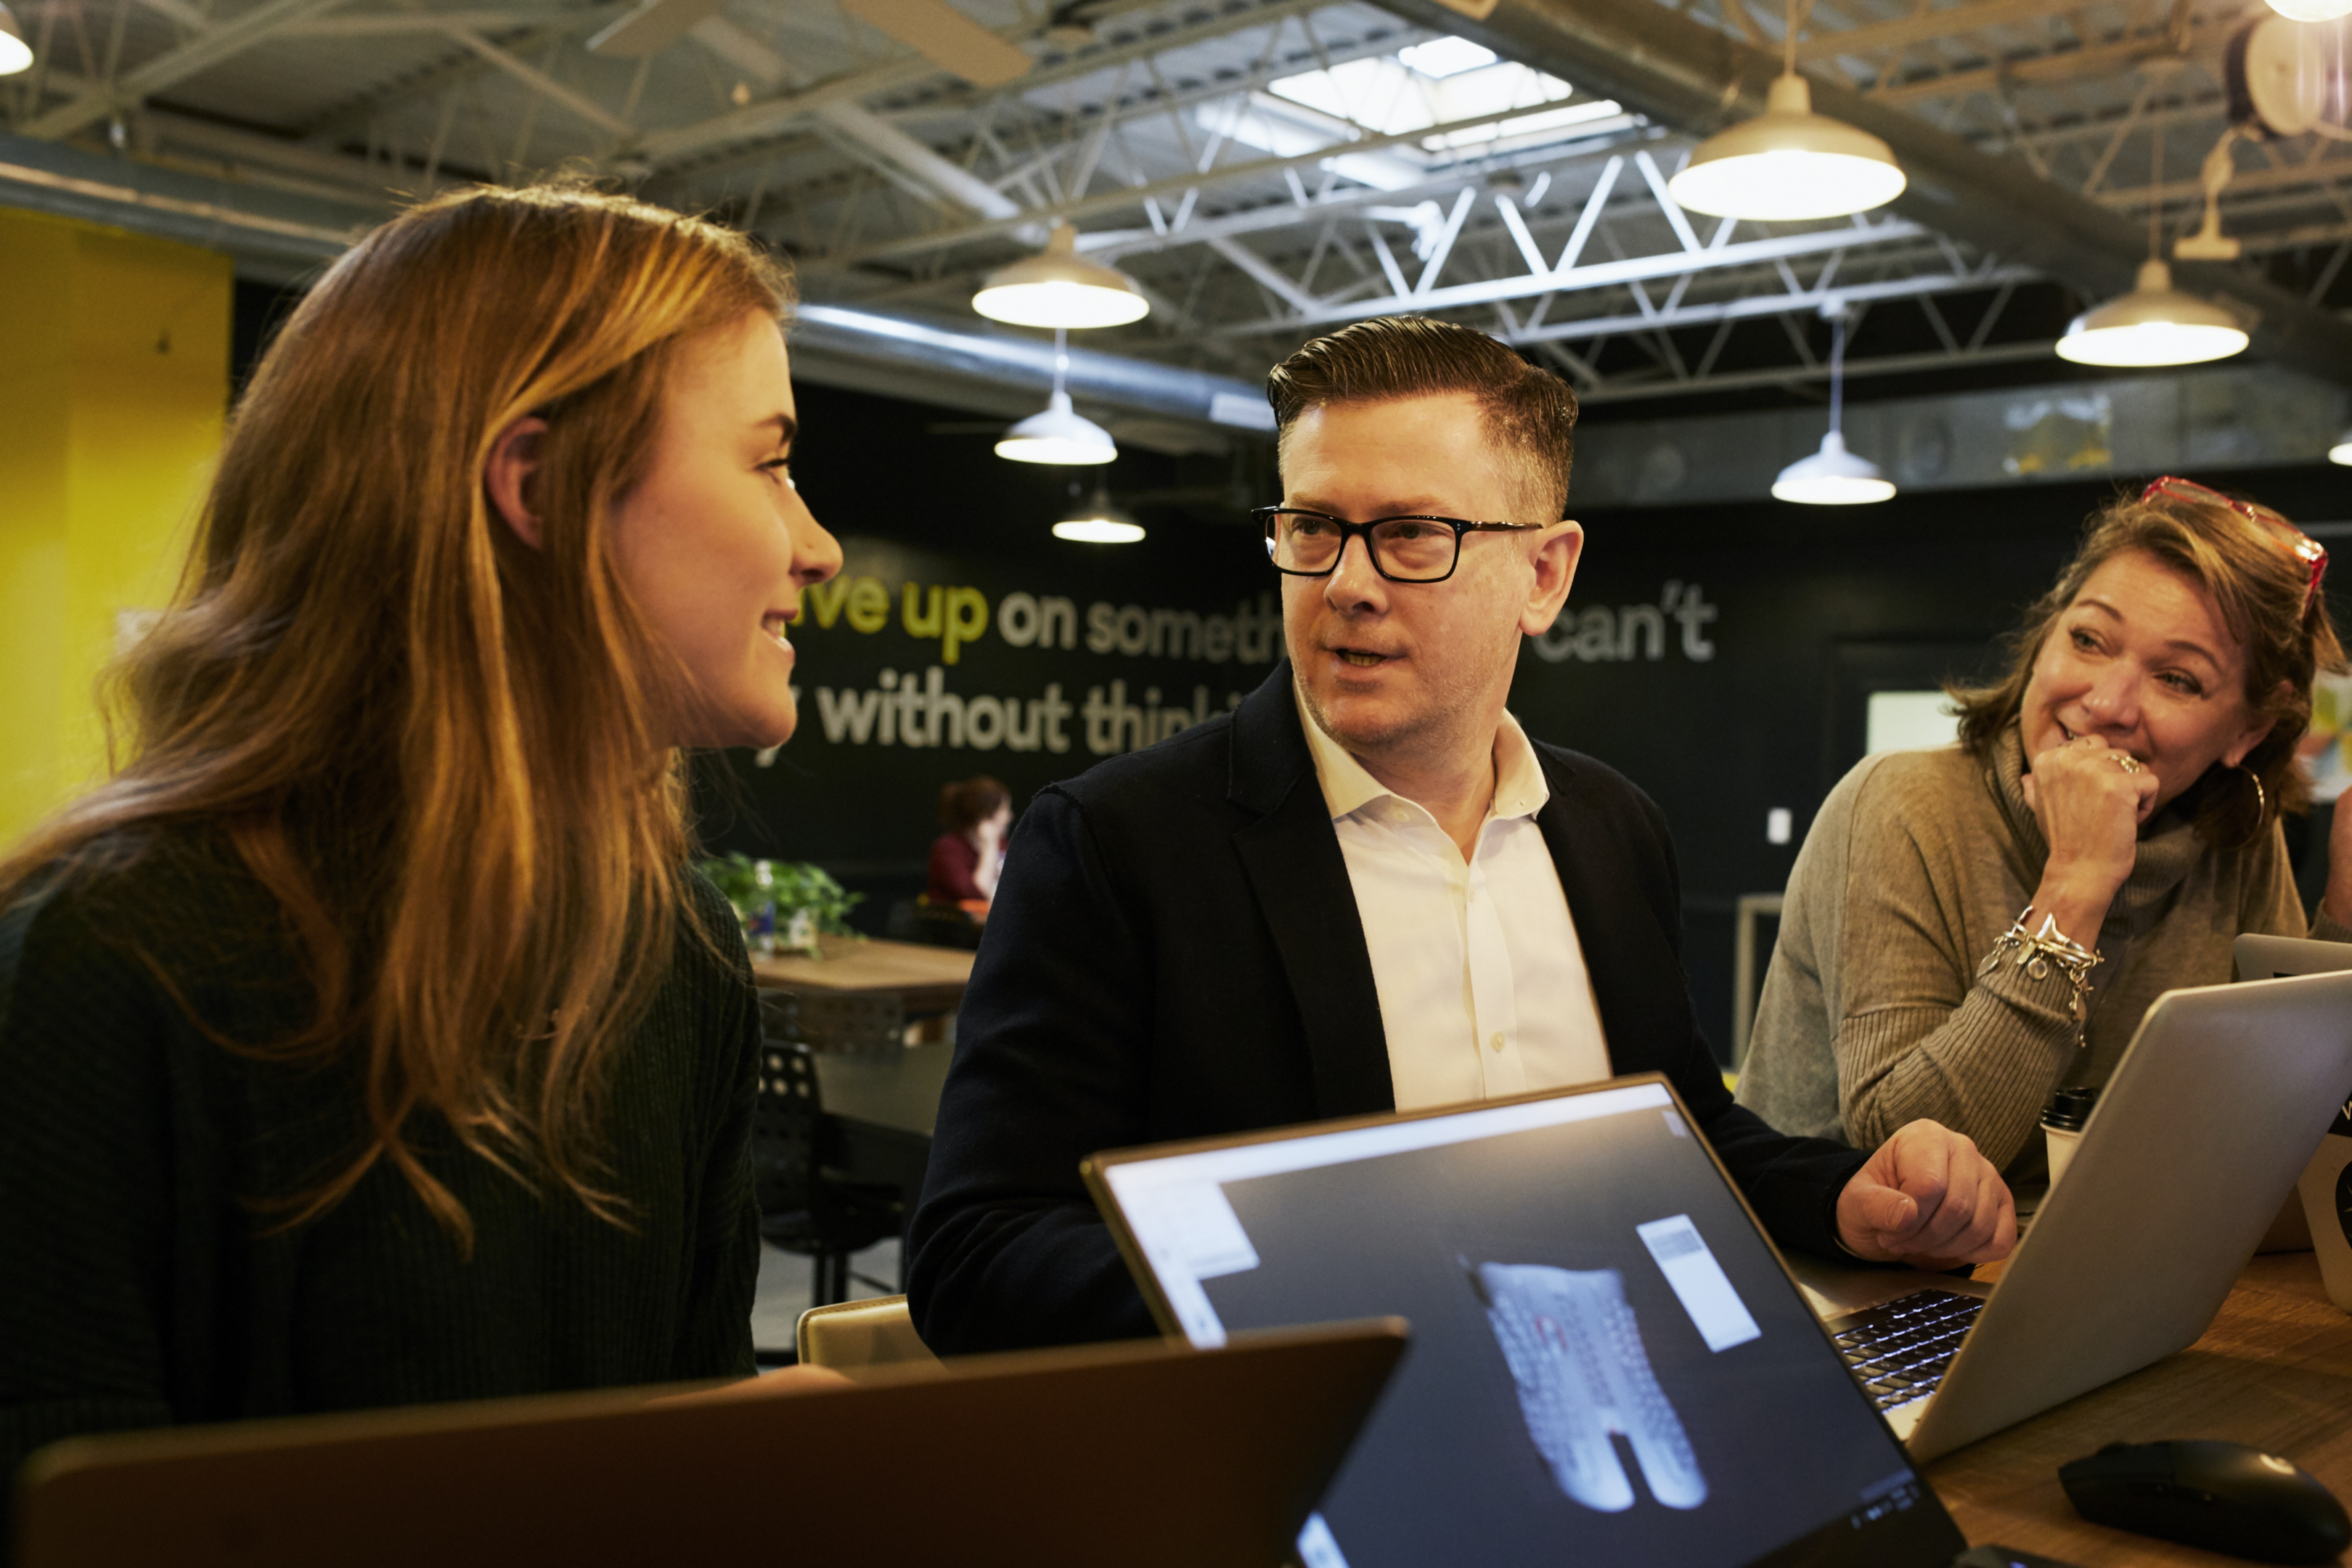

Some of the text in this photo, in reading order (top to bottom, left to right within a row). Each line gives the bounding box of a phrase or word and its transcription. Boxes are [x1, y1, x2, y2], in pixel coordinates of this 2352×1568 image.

[902, 581, 989, 665] up
[998, 591, 1077, 649] on
[1531, 578, 1719, 663] can't
[816, 665, 1073, 754] without
[1080, 677, 1243, 756] thin
